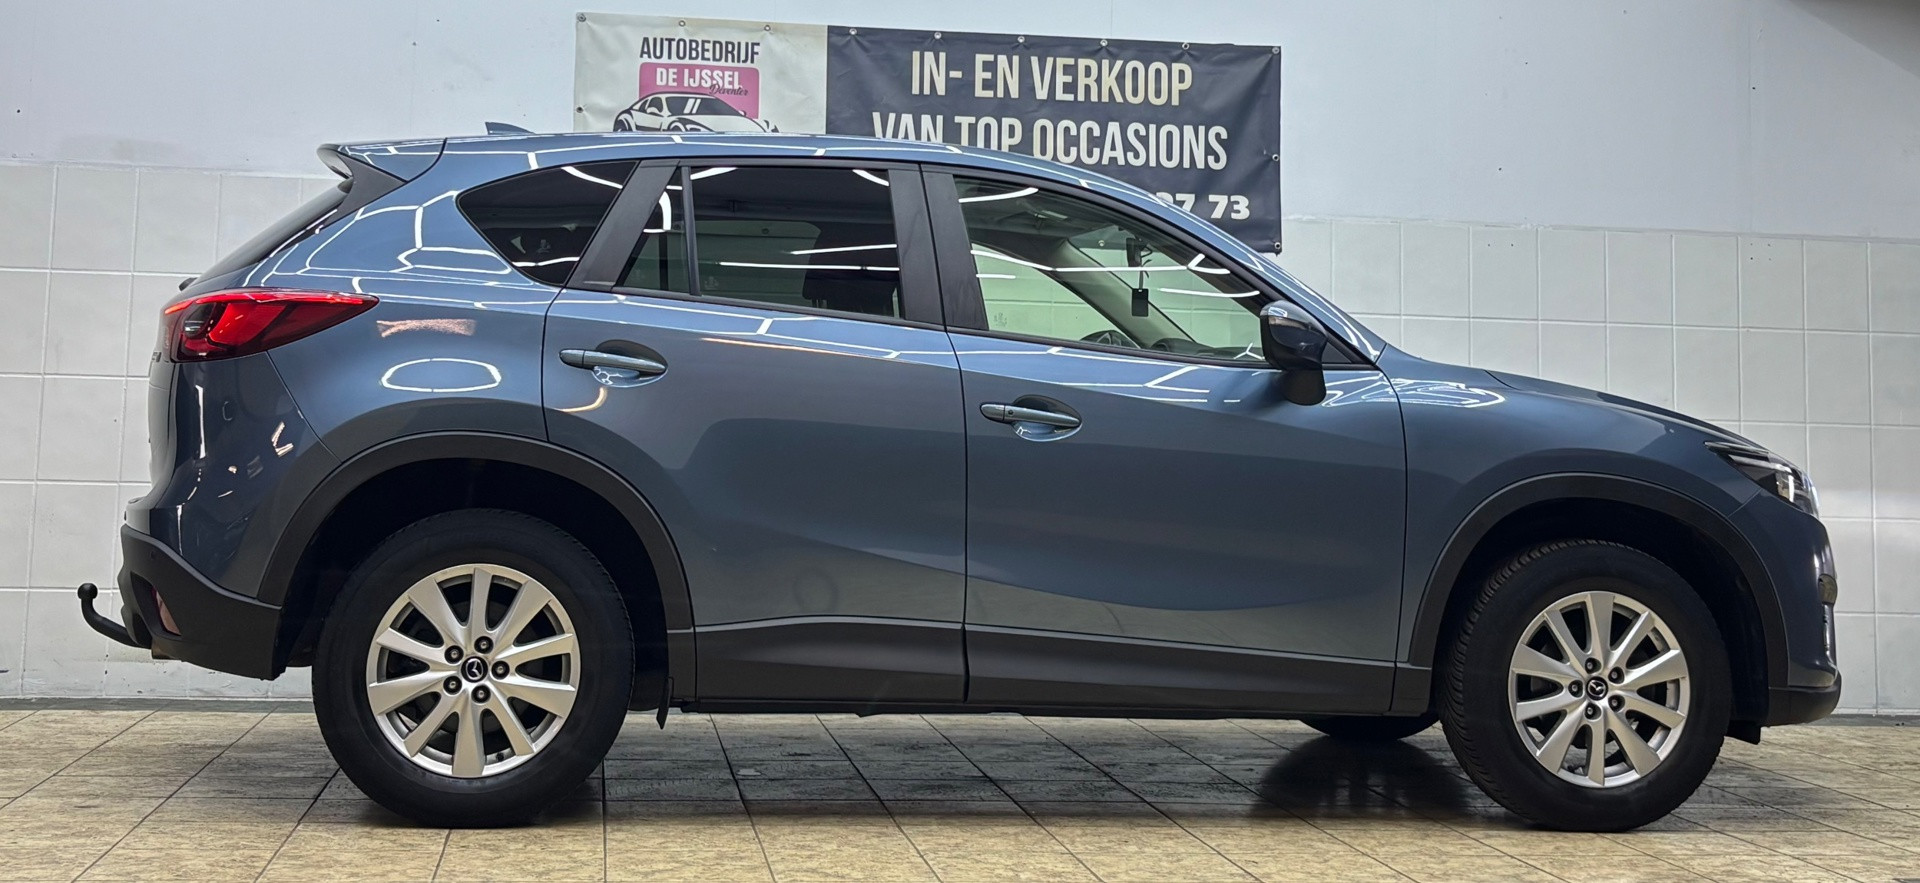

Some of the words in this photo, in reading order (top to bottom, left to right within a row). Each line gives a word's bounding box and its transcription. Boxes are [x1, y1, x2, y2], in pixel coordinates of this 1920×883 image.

[639, 36, 760, 64] AUTOBEDRIJF
[656, 67, 678, 87] DE
[683, 68, 743, 90] IJSSEL
[708, 83, 749, 97] Deventer
[911, 50, 963, 96] IN-
[974, 53, 1020, 98] EN
[1030, 55, 1193, 106] VERKOOP
[872, 111, 944, 144] VAN
[954, 115, 1023, 153] TOP
[1033, 118, 1228, 171] OCCASIONS
[1208, 194, 1251, 220] 73
